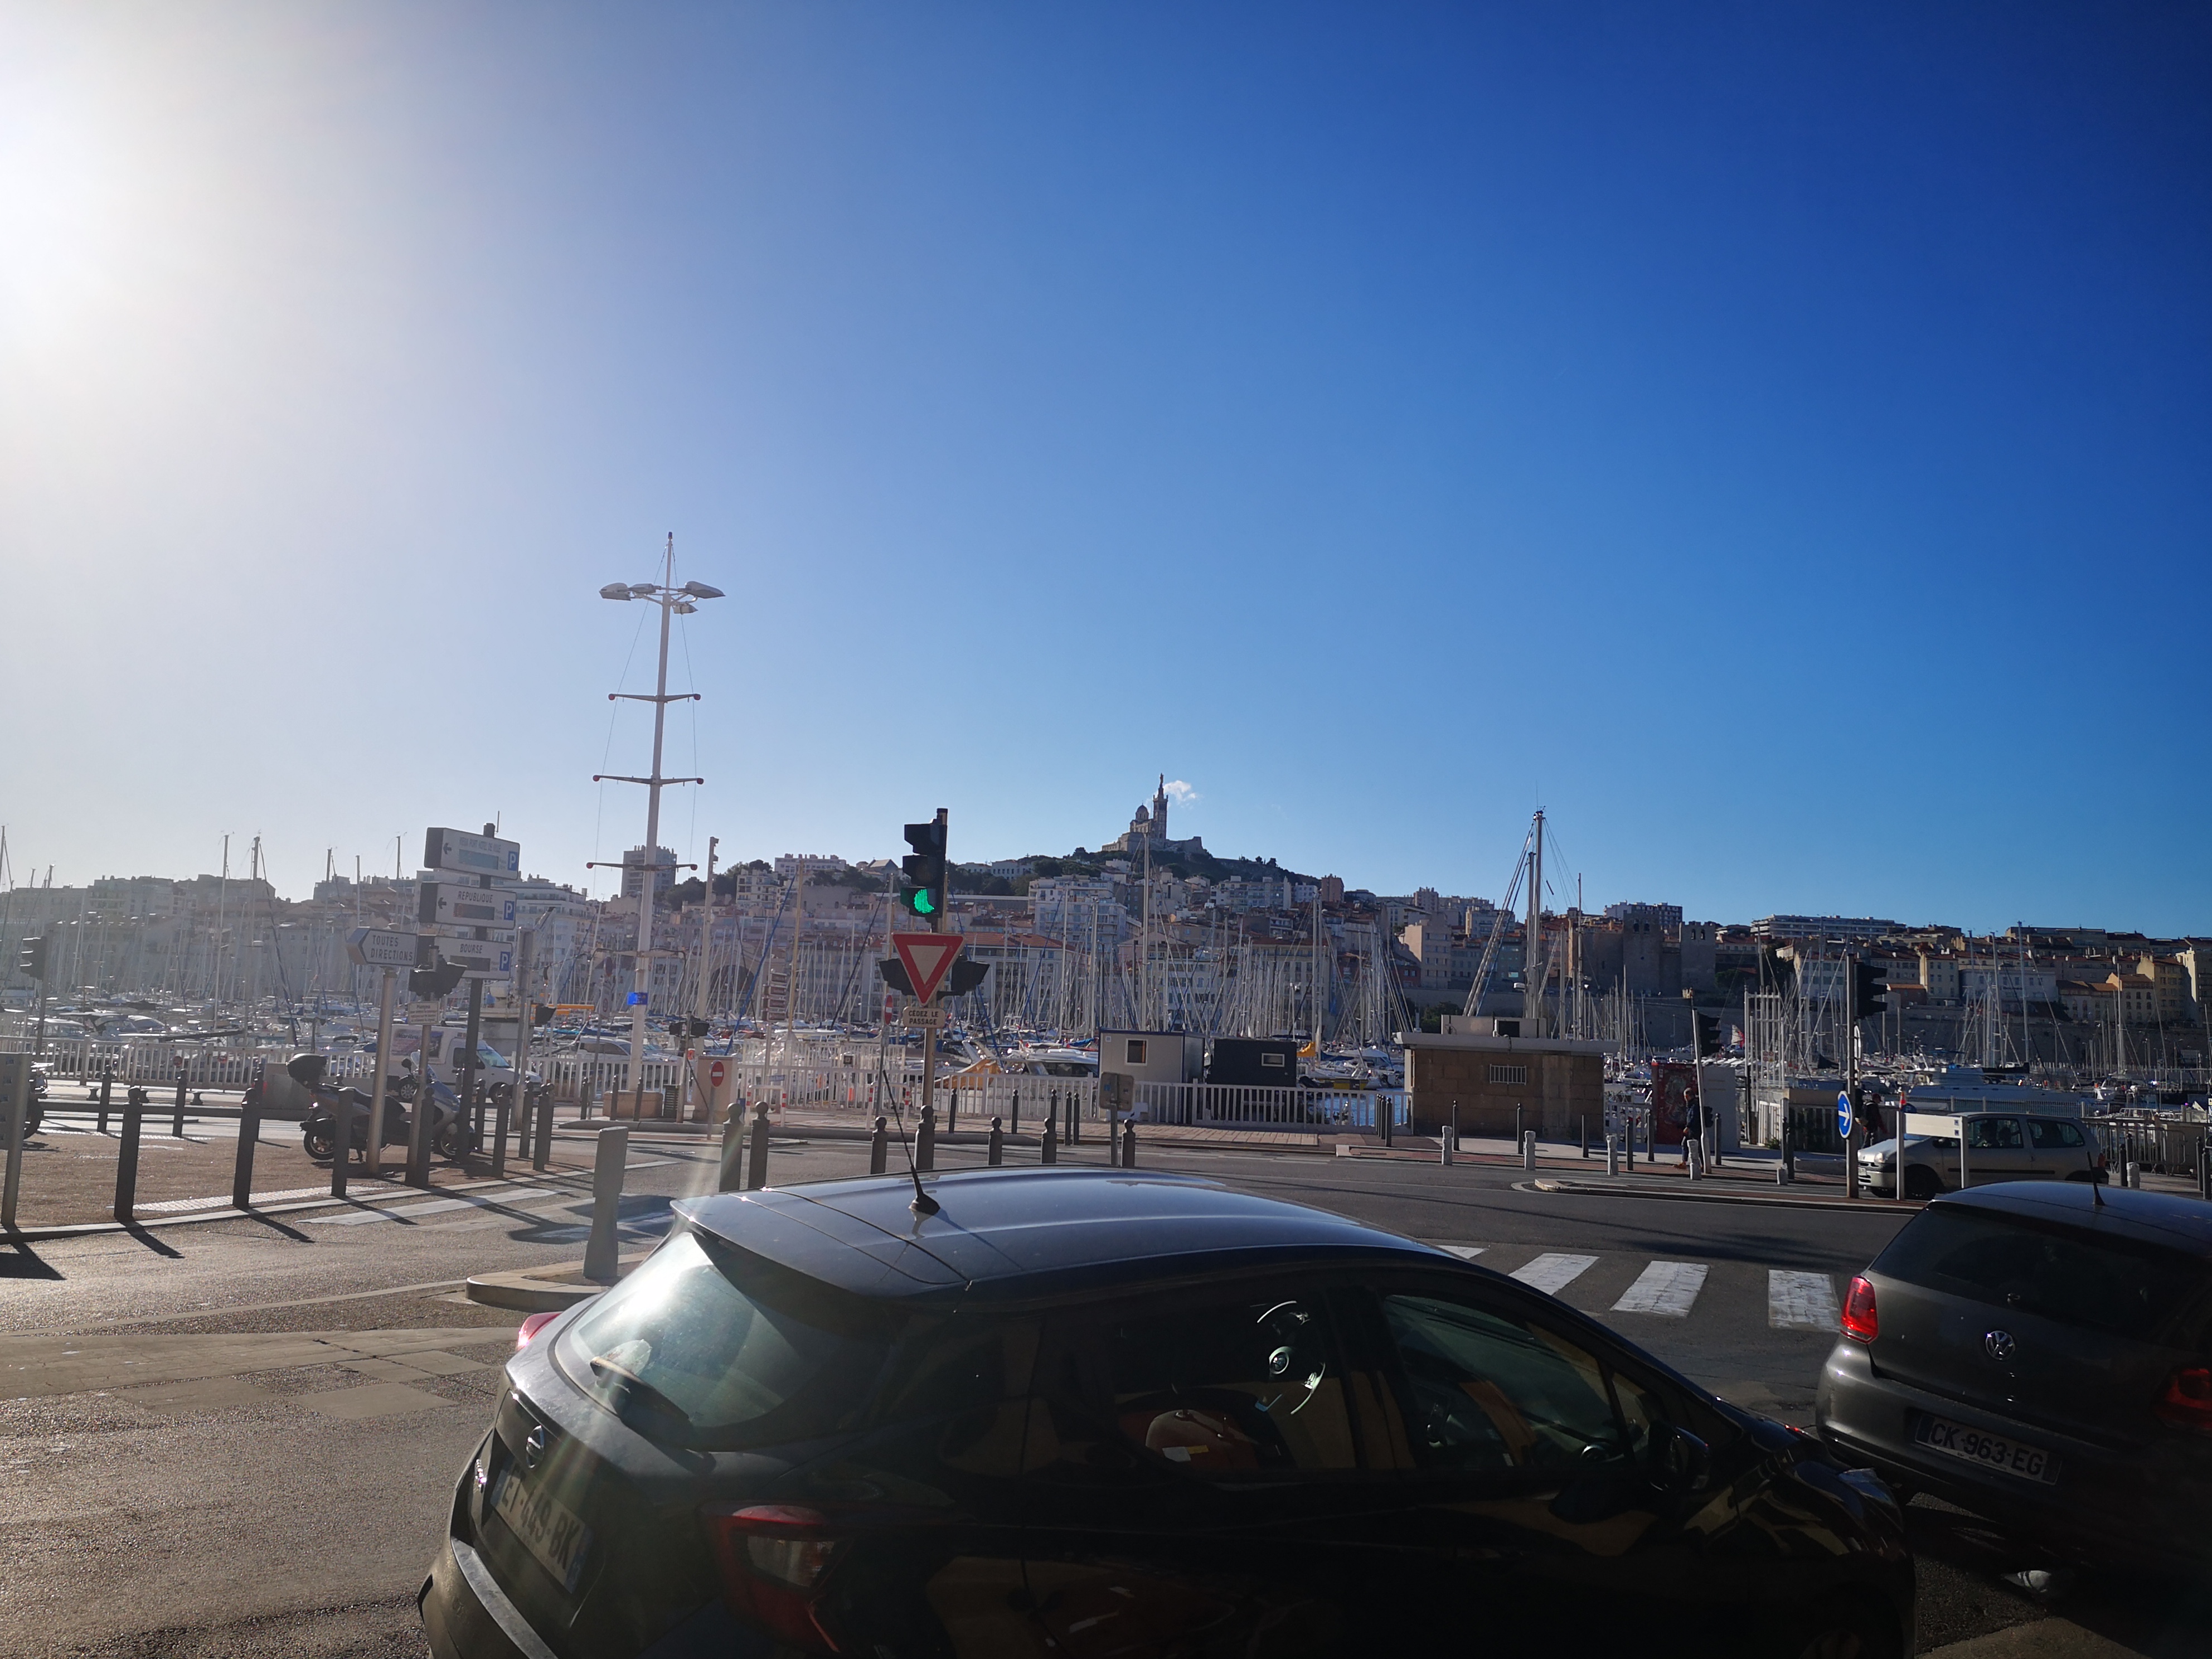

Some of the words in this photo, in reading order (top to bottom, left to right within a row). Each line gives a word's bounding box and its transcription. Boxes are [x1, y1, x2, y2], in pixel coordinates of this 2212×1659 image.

[509, 852, 516, 869] P
[506, 903, 513, 919] P
[373, 935, 399, 947] TOUTES
[459, 943, 483, 954] BOURSE
[370, 948, 413, 961] DIRECTIONS
[501, 953, 508, 969] P
[1930, 1423, 2044, 1476] CK-963-EG
